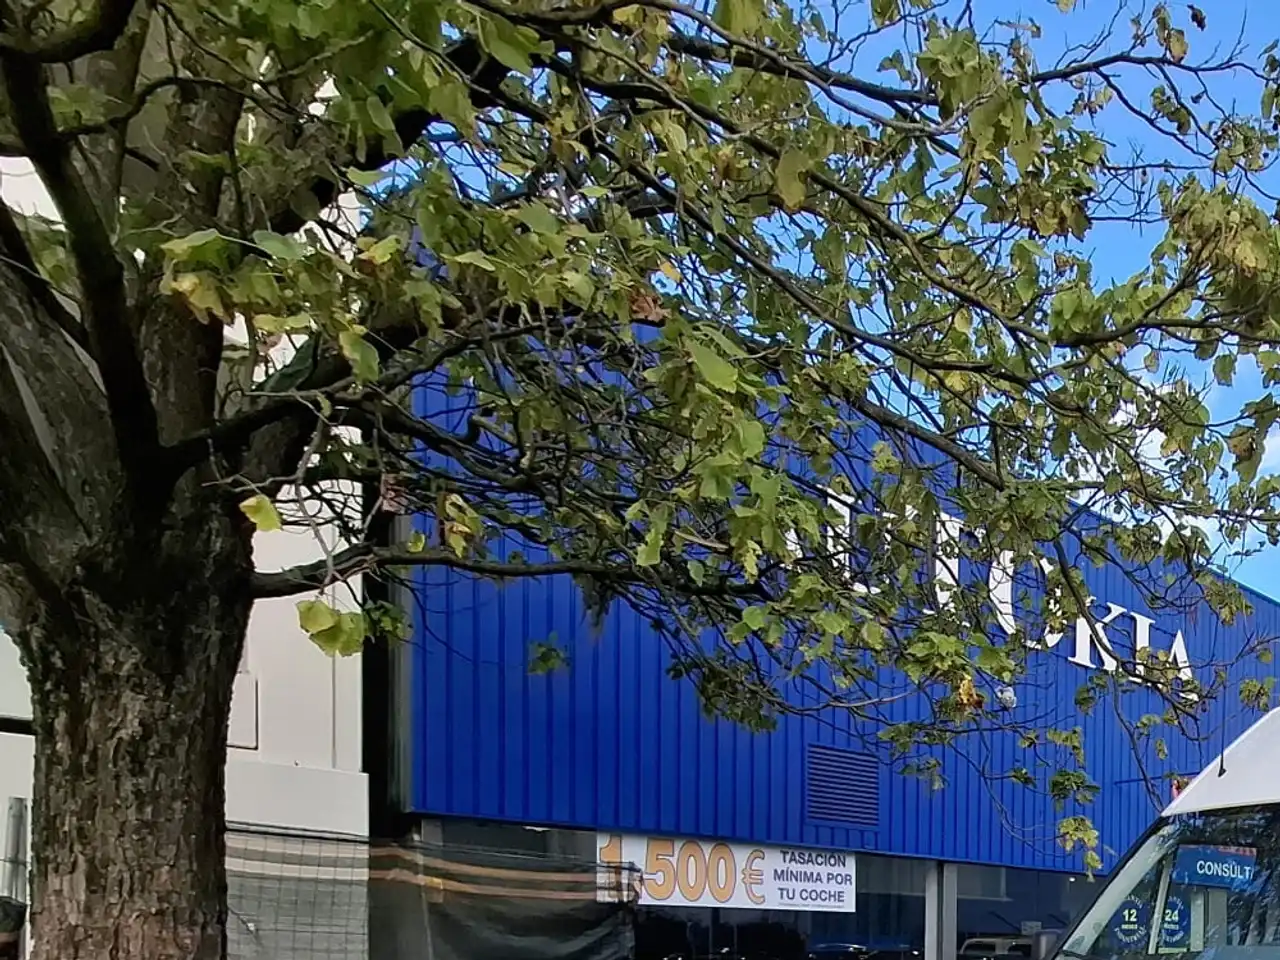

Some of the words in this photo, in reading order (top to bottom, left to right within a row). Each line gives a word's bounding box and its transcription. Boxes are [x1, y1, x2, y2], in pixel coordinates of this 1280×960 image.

[1068, 596, 1200, 701] KIA
[780, 849, 847, 868] TASACIÓN
[773, 867, 823, 884] MÍNIMA
[826, 872, 853, 887] POR
[778, 887, 796, 900] TU
[799, 888, 845, 903] COCHE
[1122, 908, 1138, 922] 12
[1164, 909, 1179, 922] 24
